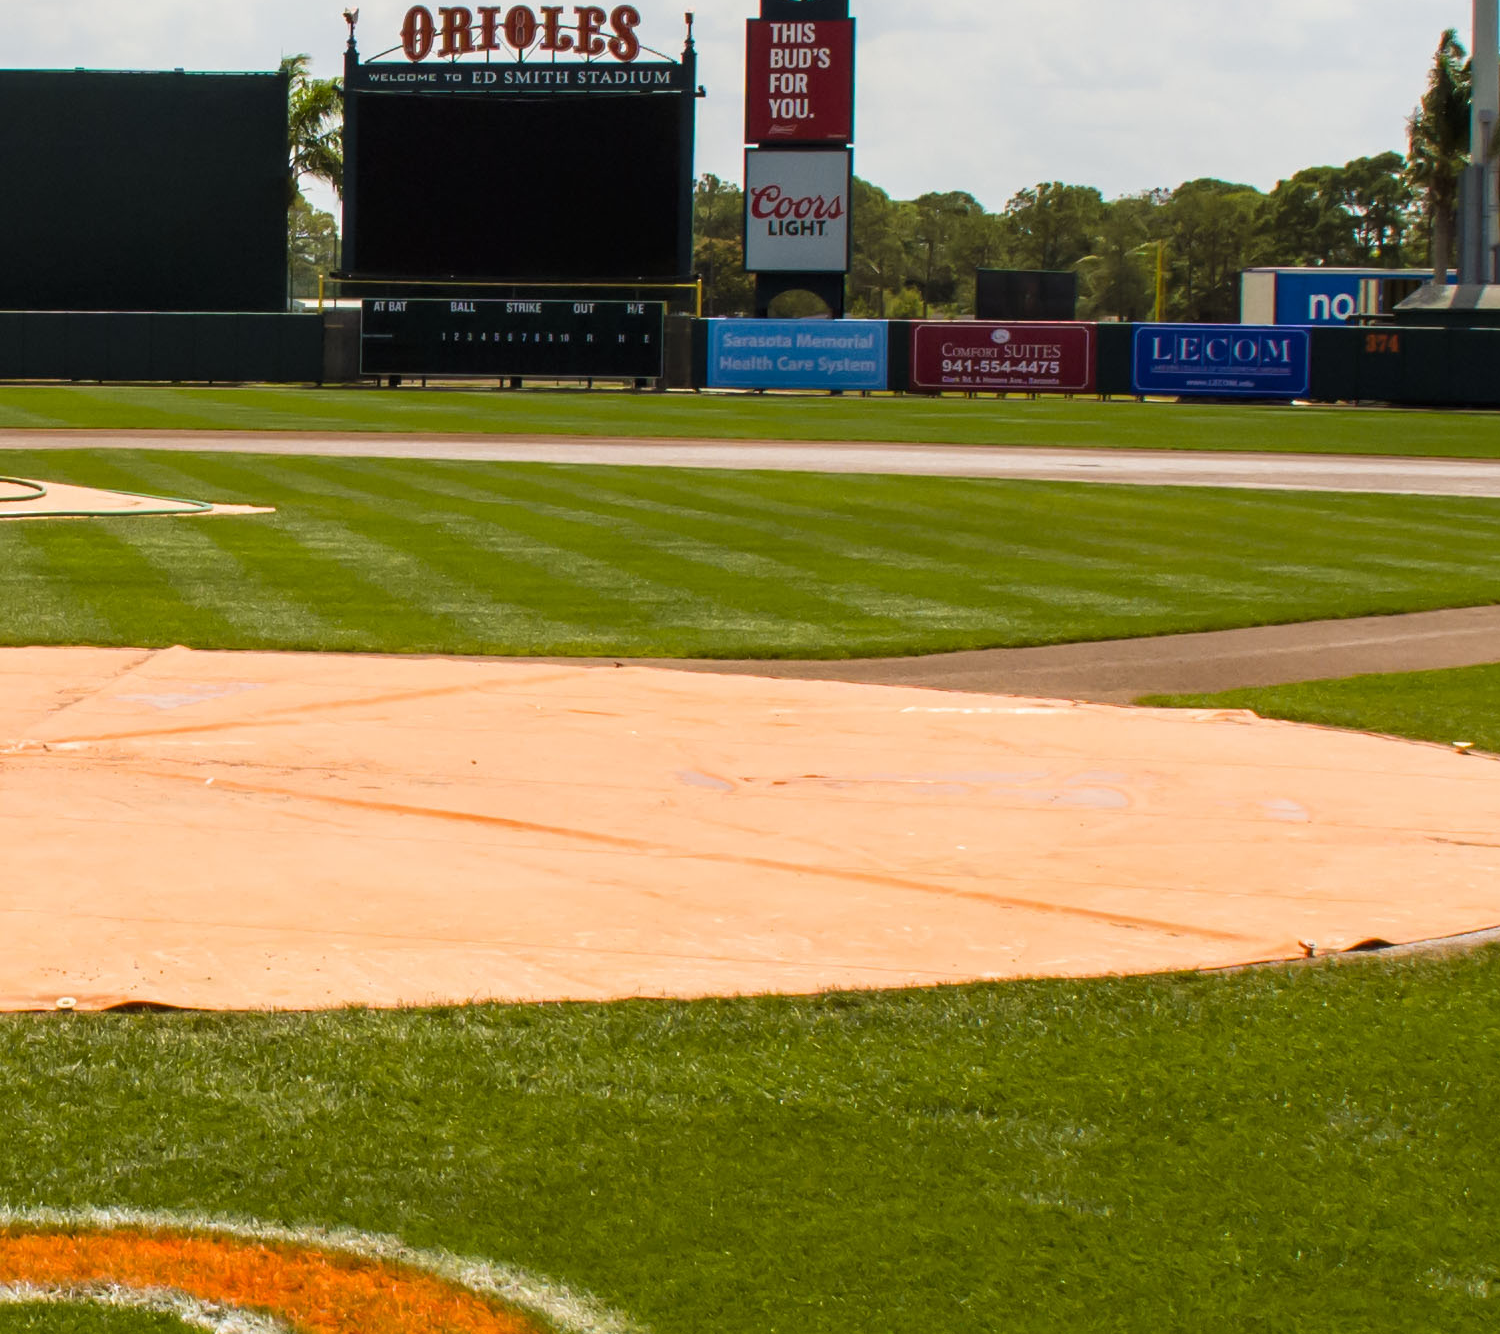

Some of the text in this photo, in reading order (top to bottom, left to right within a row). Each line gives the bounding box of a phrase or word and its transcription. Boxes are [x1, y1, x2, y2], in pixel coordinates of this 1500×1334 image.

[400, 5, 641, 62] ORIOLES
[770, 23, 815, 43] THIS
[770, 48, 831, 68] BUD'S
[369, 72, 671, 84] WELCOME TO ED SMITH STADIUM
[769, 73, 808, 93] FOR
[769, 98, 814, 118] YOU.
[750, 185, 844, 219] Coors
[768, 220, 826, 236] LIGHT
[373, 301, 407, 312] AT BAT
[450, 302, 476, 312] BALL
[506, 303, 542, 313] STRIKE
[573, 303, 595, 314] OUT
[626, 303, 645, 314] H/E
[442, 333, 446, 341] 1
[454, 333, 459, 341] 2
[481, 333, 486, 341] 4
[522, 333, 527, 342] 7
[560, 333, 570, 342] 10
[618, 333, 625, 343] H
[722, 334, 874, 348] Sarasota Memorial
[1004, 344, 1061, 359] SUITES
[1152, 337, 1291, 362] LECOM
[720, 356, 876, 374] Health Care System
[942, 360, 1060, 374] 941-554-4475
